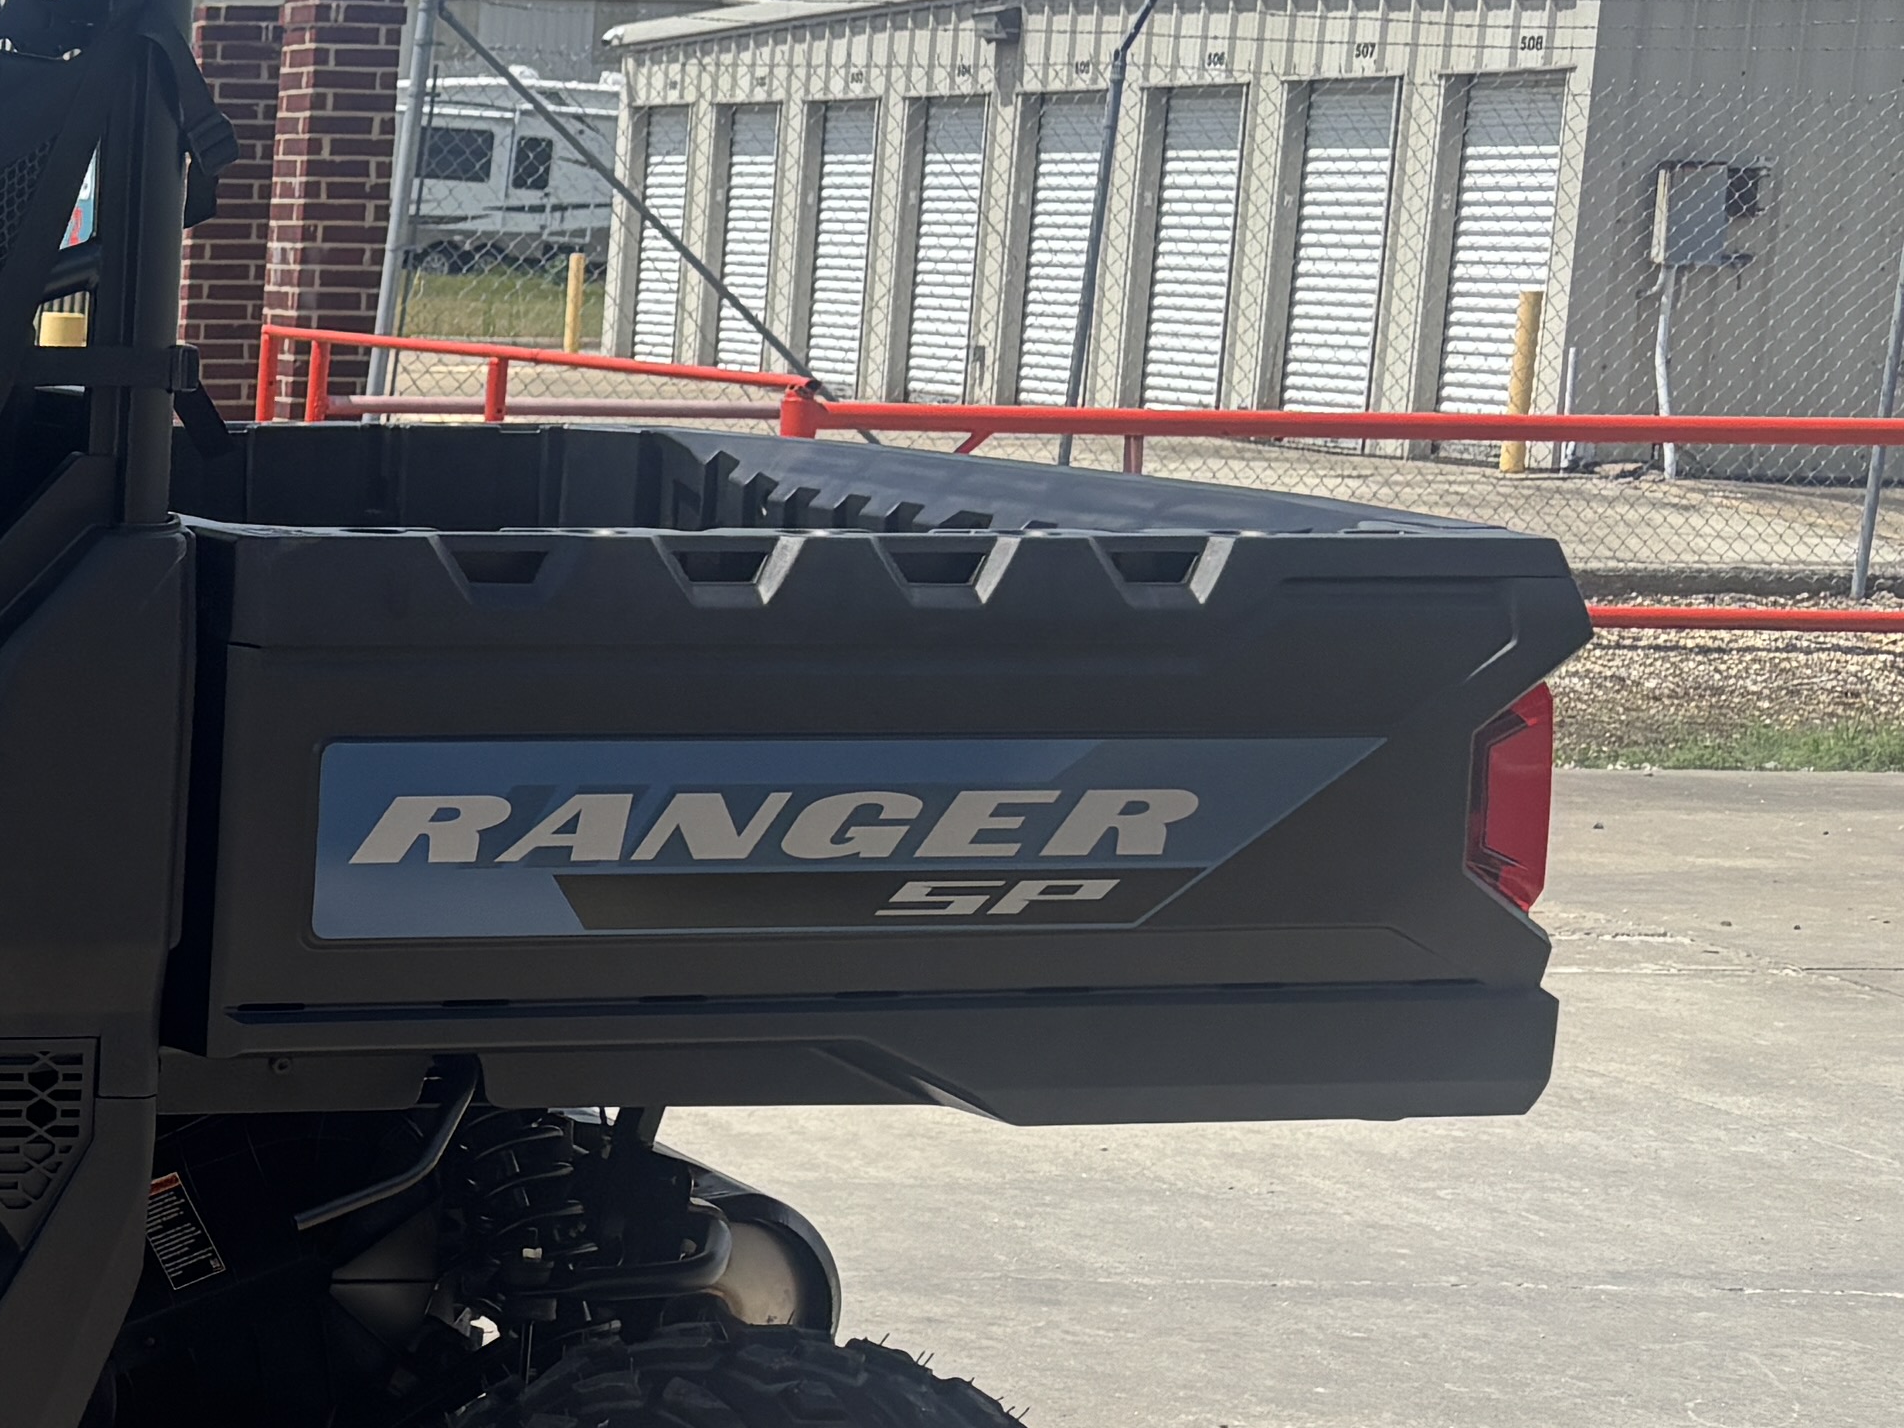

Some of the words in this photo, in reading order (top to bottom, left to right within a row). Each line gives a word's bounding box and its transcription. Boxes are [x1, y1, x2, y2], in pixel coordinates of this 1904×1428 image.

[1355, 43, 1376, 60] 507
[1520, 35, 1543, 52] 508
[348, 789, 1199, 865] RANGER
[875, 879, 1122, 917] SP
